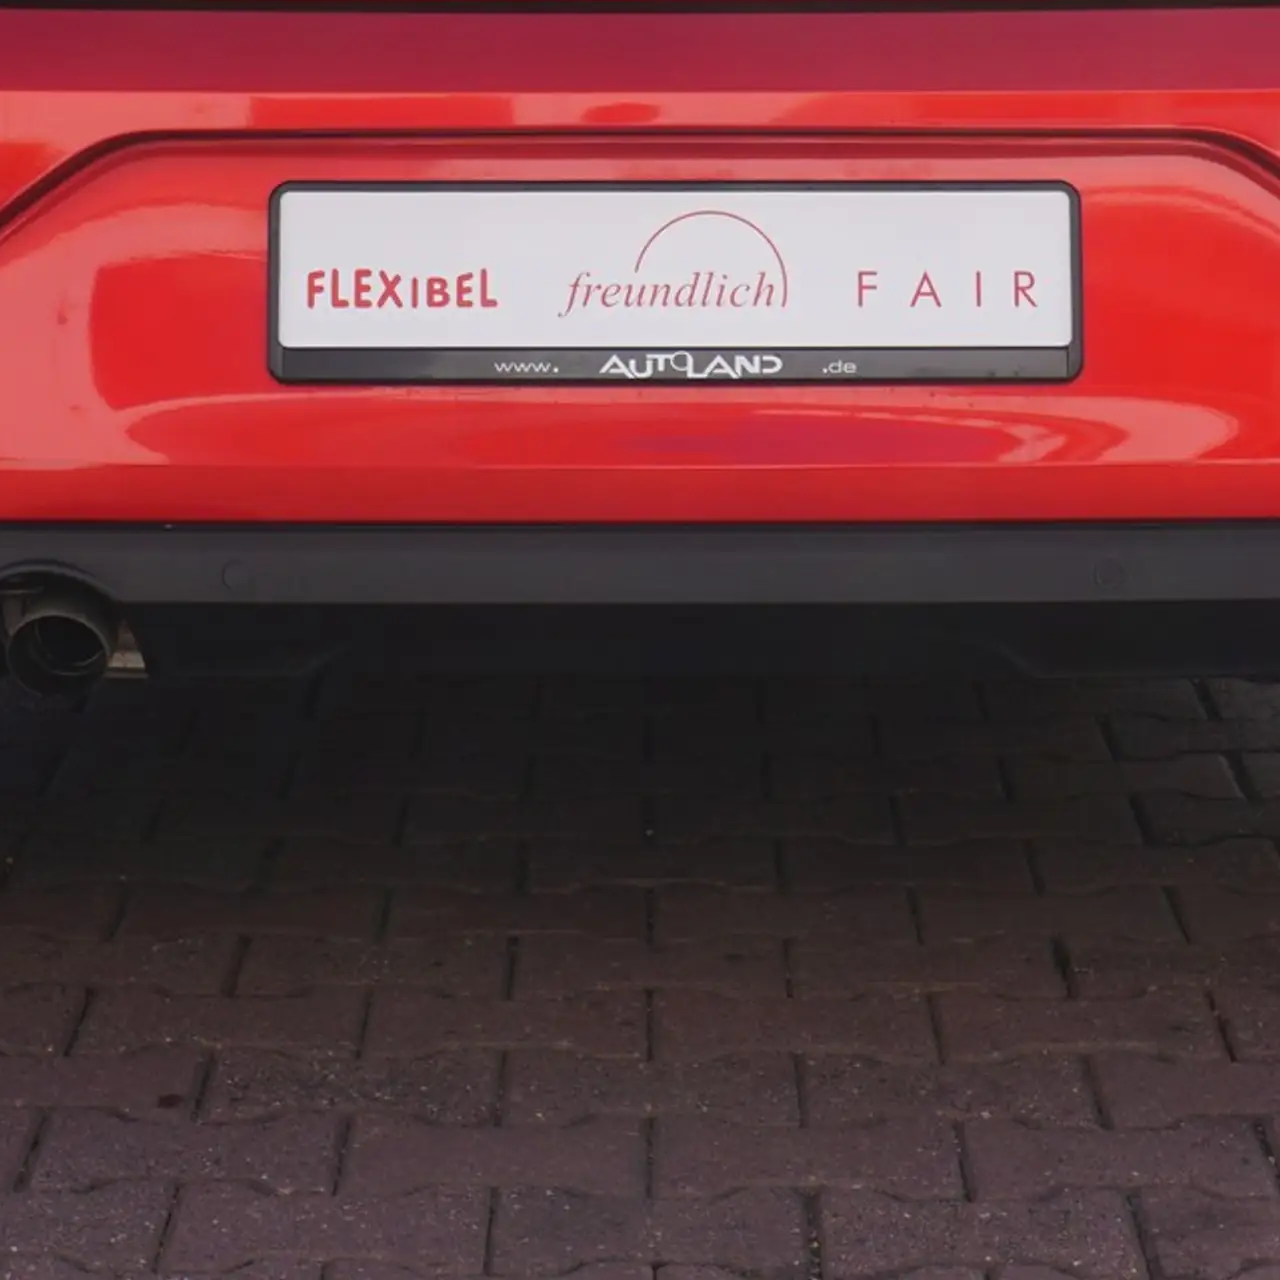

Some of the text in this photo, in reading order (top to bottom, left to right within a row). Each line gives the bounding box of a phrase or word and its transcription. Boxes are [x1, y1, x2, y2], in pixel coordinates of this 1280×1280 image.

[306, 268, 1038, 318] FLEXIBEL freundlich FAIR
